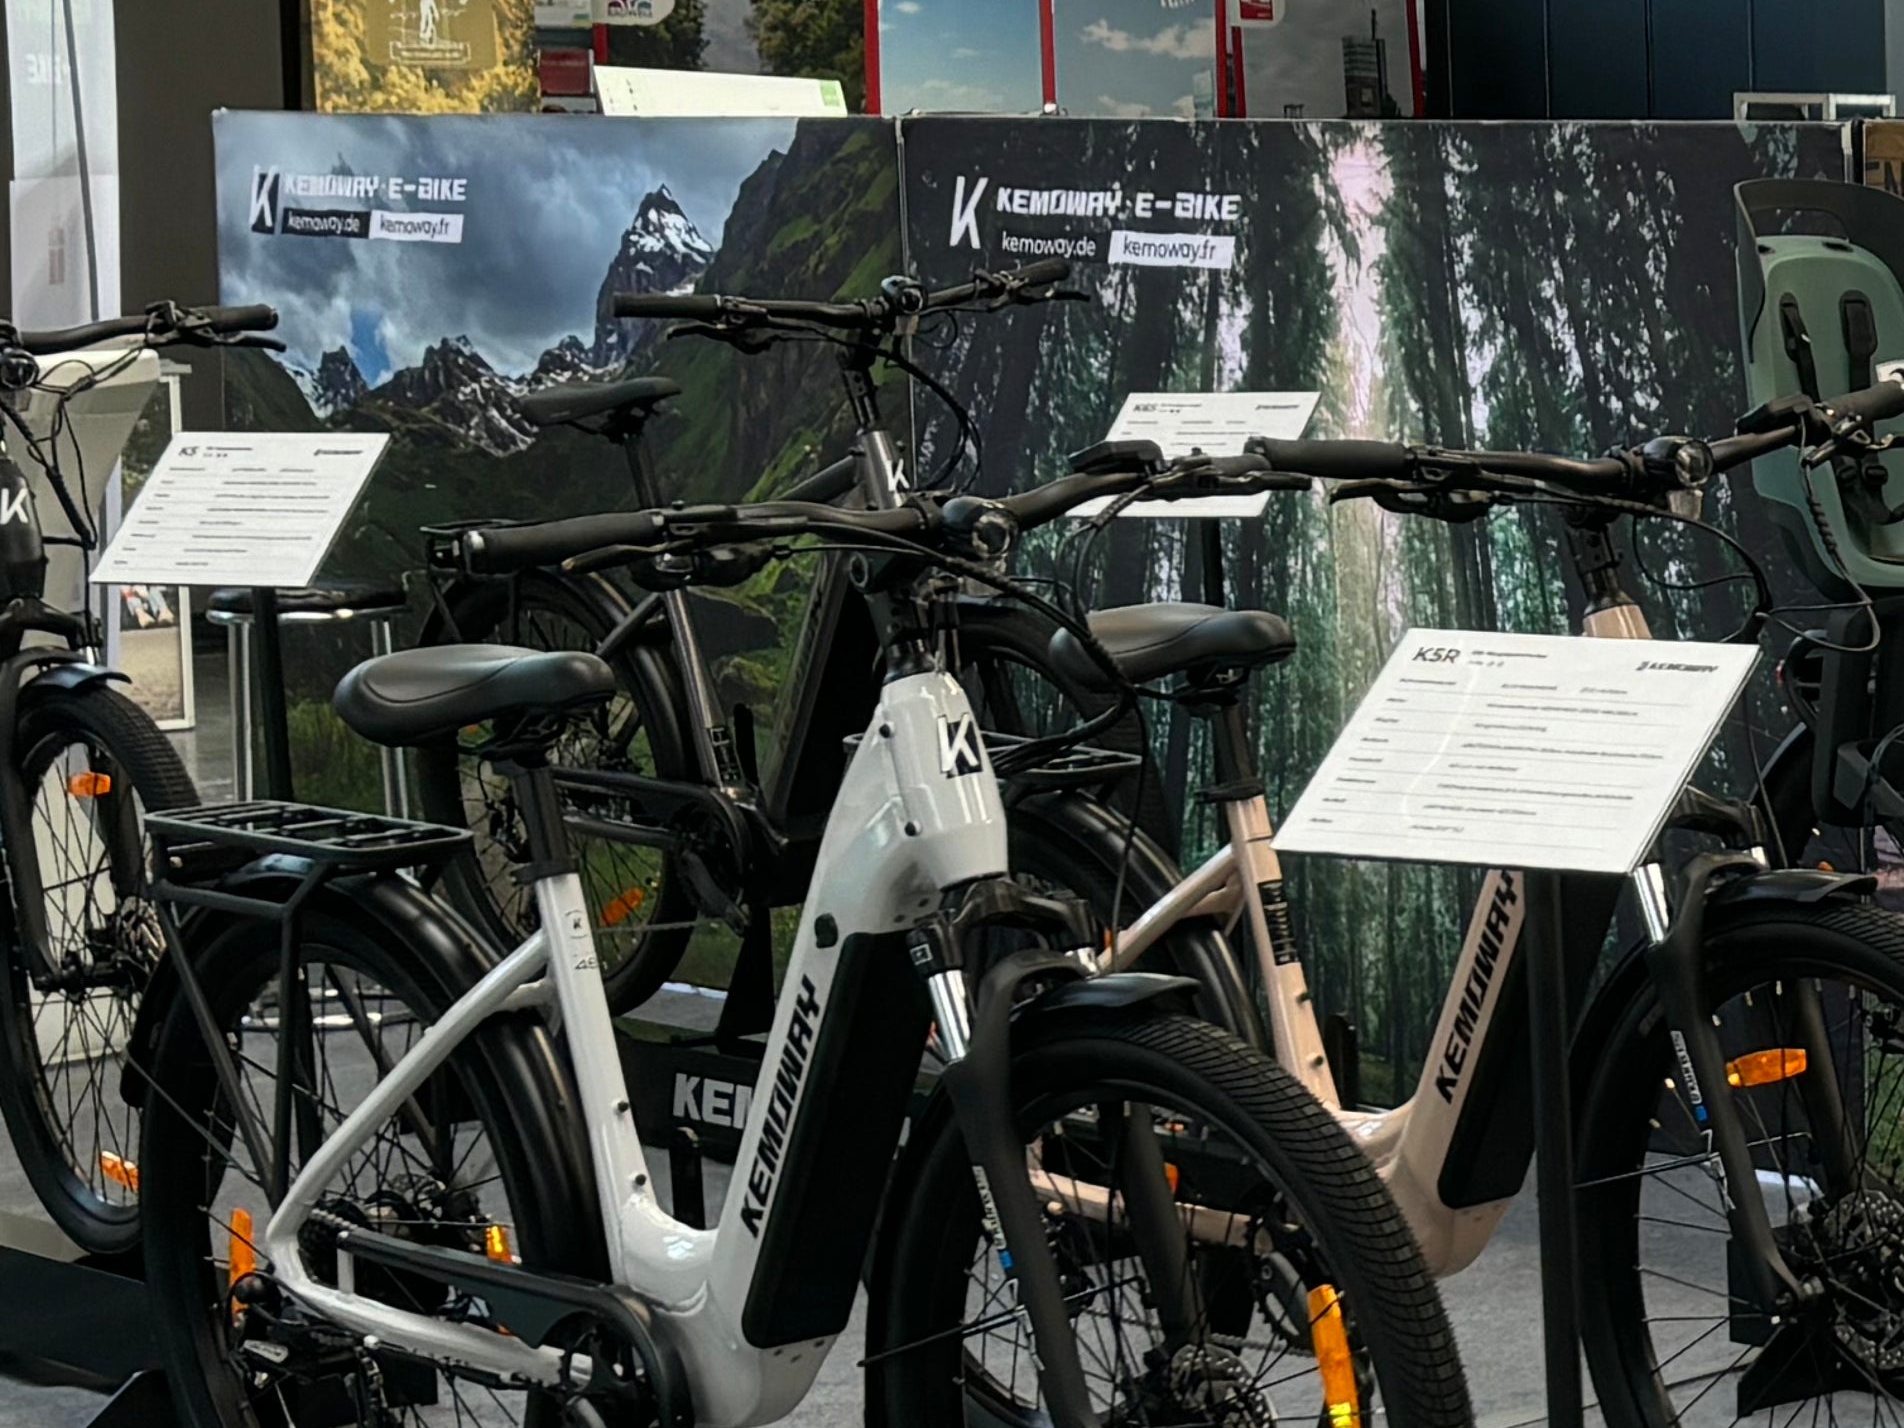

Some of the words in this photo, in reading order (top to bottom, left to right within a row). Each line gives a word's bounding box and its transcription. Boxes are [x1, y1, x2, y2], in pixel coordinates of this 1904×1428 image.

[284, 174, 379, 198] KEMOWAY
[388, 176, 468, 201] E-BIKE
[996, 186, 1122, 217] KEMOWAY
[1135, 192, 1242, 221] E-BIKE
[288, 211, 360, 234] kemoway.de
[380, 214, 450, 239] kemoway.fr
[950, 175, 989, 249] K
[1002, 230, 1097, 259] kemoway.de
[1123, 234, 1217, 264] kemoway.fr
[1411, 645, 1461, 665] K5R
[1434, 866, 1523, 1105] KEMOWAY
[738, 971, 821, 1240] KEMOWAY
